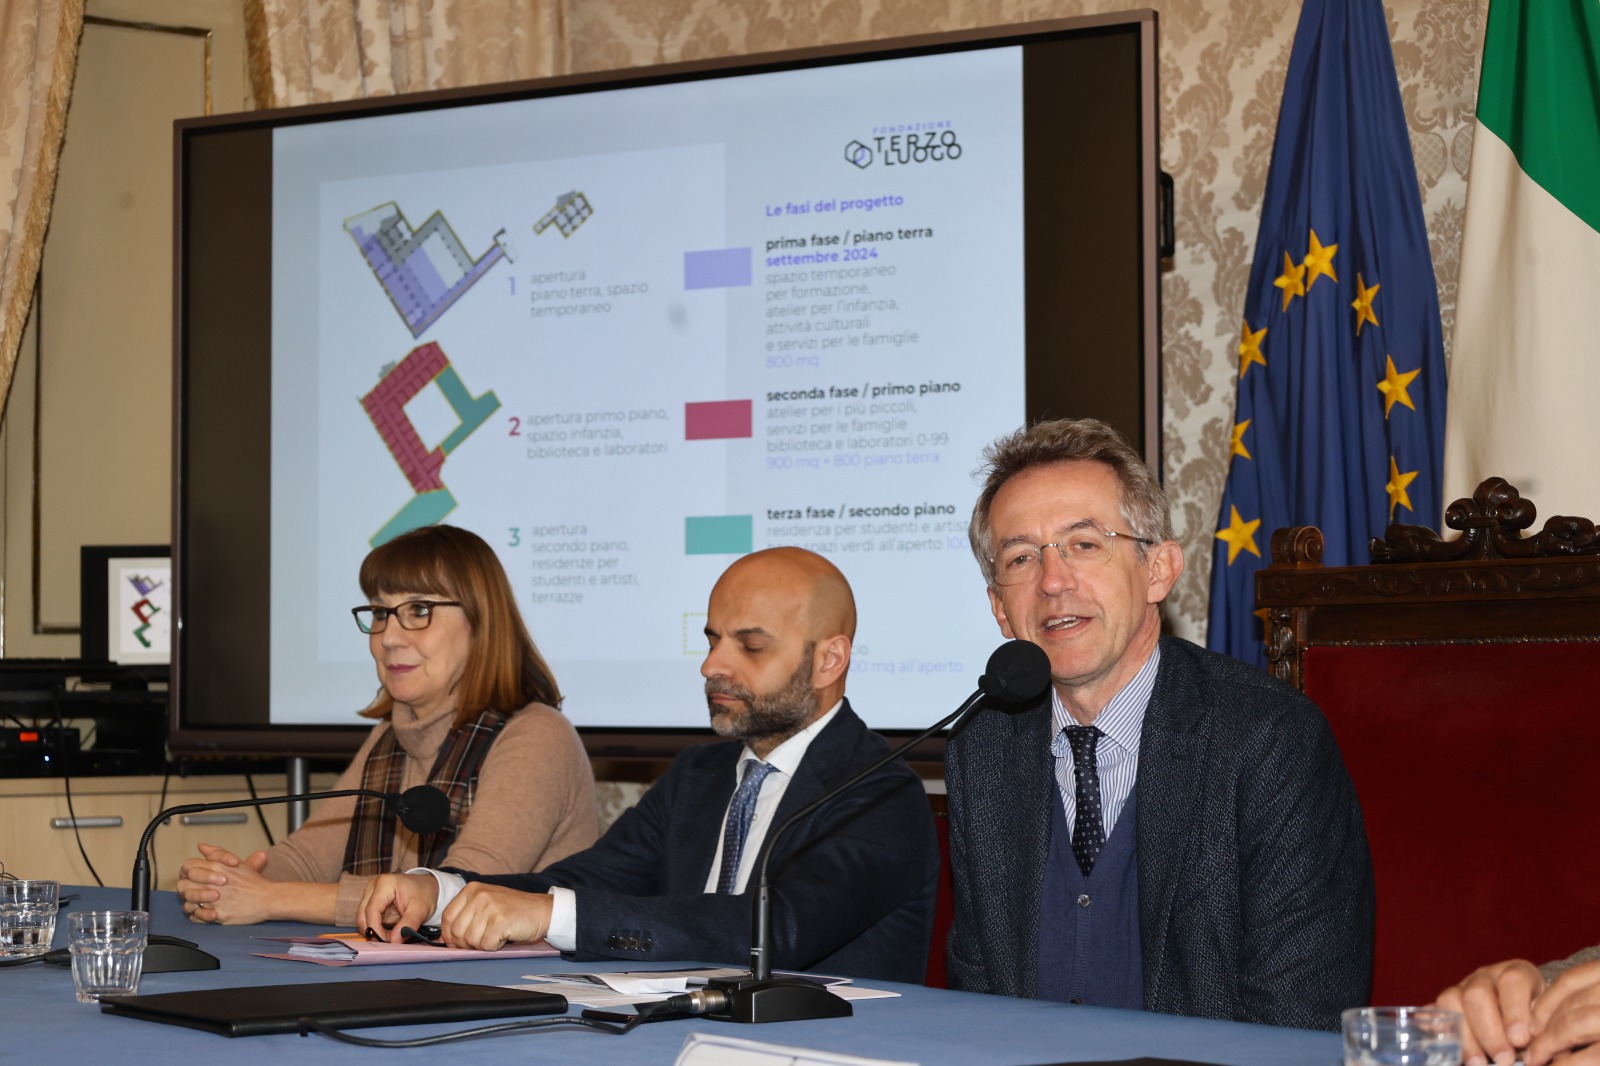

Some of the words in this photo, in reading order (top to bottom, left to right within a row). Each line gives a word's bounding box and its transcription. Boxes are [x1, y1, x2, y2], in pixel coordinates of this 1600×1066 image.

[872, 120, 952, 134] FONDAZIONE
[873, 130, 956, 153] TERZO
[884, 143, 962, 166] LUOGO
[766, 204, 782, 216] Le
[786, 200, 810, 214] fasi
[814, 198, 836, 212] del
[840, 194, 904, 211] progetto
[766, 236, 806, 251] prima
[811, 233, 839, 247] fase
[853, 230, 893, 246] piano
[898, 226, 933, 240] terra
[766, 250, 838, 267] settembre
[843, 247, 878, 261] 2024
[530, 270, 587, 284] apertura
[766, 270, 808, 284] spazio
[811, 263, 896, 281] temporaneo
[508, 276, 516, 296] 1
[530, 289, 567, 304] piano
[569, 286, 604, 299] terra,
[606, 281, 648, 297] spazio
[766, 287, 788, 302] per
[791, 281, 871, 299] formazione,
[530, 302, 613, 319] temporaneo
[766, 303, 806, 318] atelier
[810, 303, 833, 316] per
[836, 298, 899, 312] l'infanzia,
[766, 320, 811, 335] attività
[815, 317, 870, 332] culturali
[777, 337, 817, 351] servizi
[821, 335, 843, 350] per
[847, 332, 859, 346] le
[862, 330, 919, 348] famiglie
[766, 354, 792, 369] 800
[795, 354, 819, 369] mq
[766, 387, 825, 402] seconda
[829, 385, 858, 399] fase
[872, 382, 915, 398] primo
[919, 380, 961, 396] piano
[527, 412, 582, 427] apertura
[585, 411, 625, 426] primo
[628, 407, 669, 422] piano,
[766, 403, 807, 419] atelier
[811, 405, 834, 419] per
[844, 400, 866, 416] più
[869, 399, 917, 416] piccoli,
[508, 416, 521, 436] 2
[527, 428, 567, 443] spazio
[570, 425, 624, 440] infanzia,
[766, 423, 807, 436] servizi
[810, 422, 833, 437] per
[836, 418, 849, 432] le
[852, 416, 907, 434] famiglie
[527, 446, 590, 460] biblioteca
[604, 440, 668, 456] laboratori
[766, 438, 831, 454] biblioteca
[847, 433, 914, 449] laboratori
[916, 431, 949, 447] 0-99
[766, 454, 792, 469] 900
[795, 456, 820, 470] mq
[833, 452, 861, 466] 800
[863, 451, 902, 467] piano
[905, 450, 940, 464] terra
[766, 507, 801, 521] terza
[805, 504, 835, 520] fase
[849, 501, 910, 518] secondo
[914, 500, 956, 516] piano
[507, 527, 521, 547] 3
[531, 523, 588, 537] apertura
[766, 520, 832, 537] residenza
[834, 523, 857, 538] per
[863, 518, 918, 534] studenti
[933, 519, 970, 533] artist
[531, 540, 587, 554] secondo
[590, 538, 630, 554] piano,
[843, 535, 876, 550] verdi
[879, 533, 943, 550] all'aperto
[531, 554, 594, 570] residenze
[597, 556, 619, 571] per
[531, 573, 587, 588] studenti
[600, 572, 640, 587] artisti,
[531, 590, 584, 605] terrazze
[871, 660, 896, 674] mq
[899, 658, 963, 674] all'aperto
